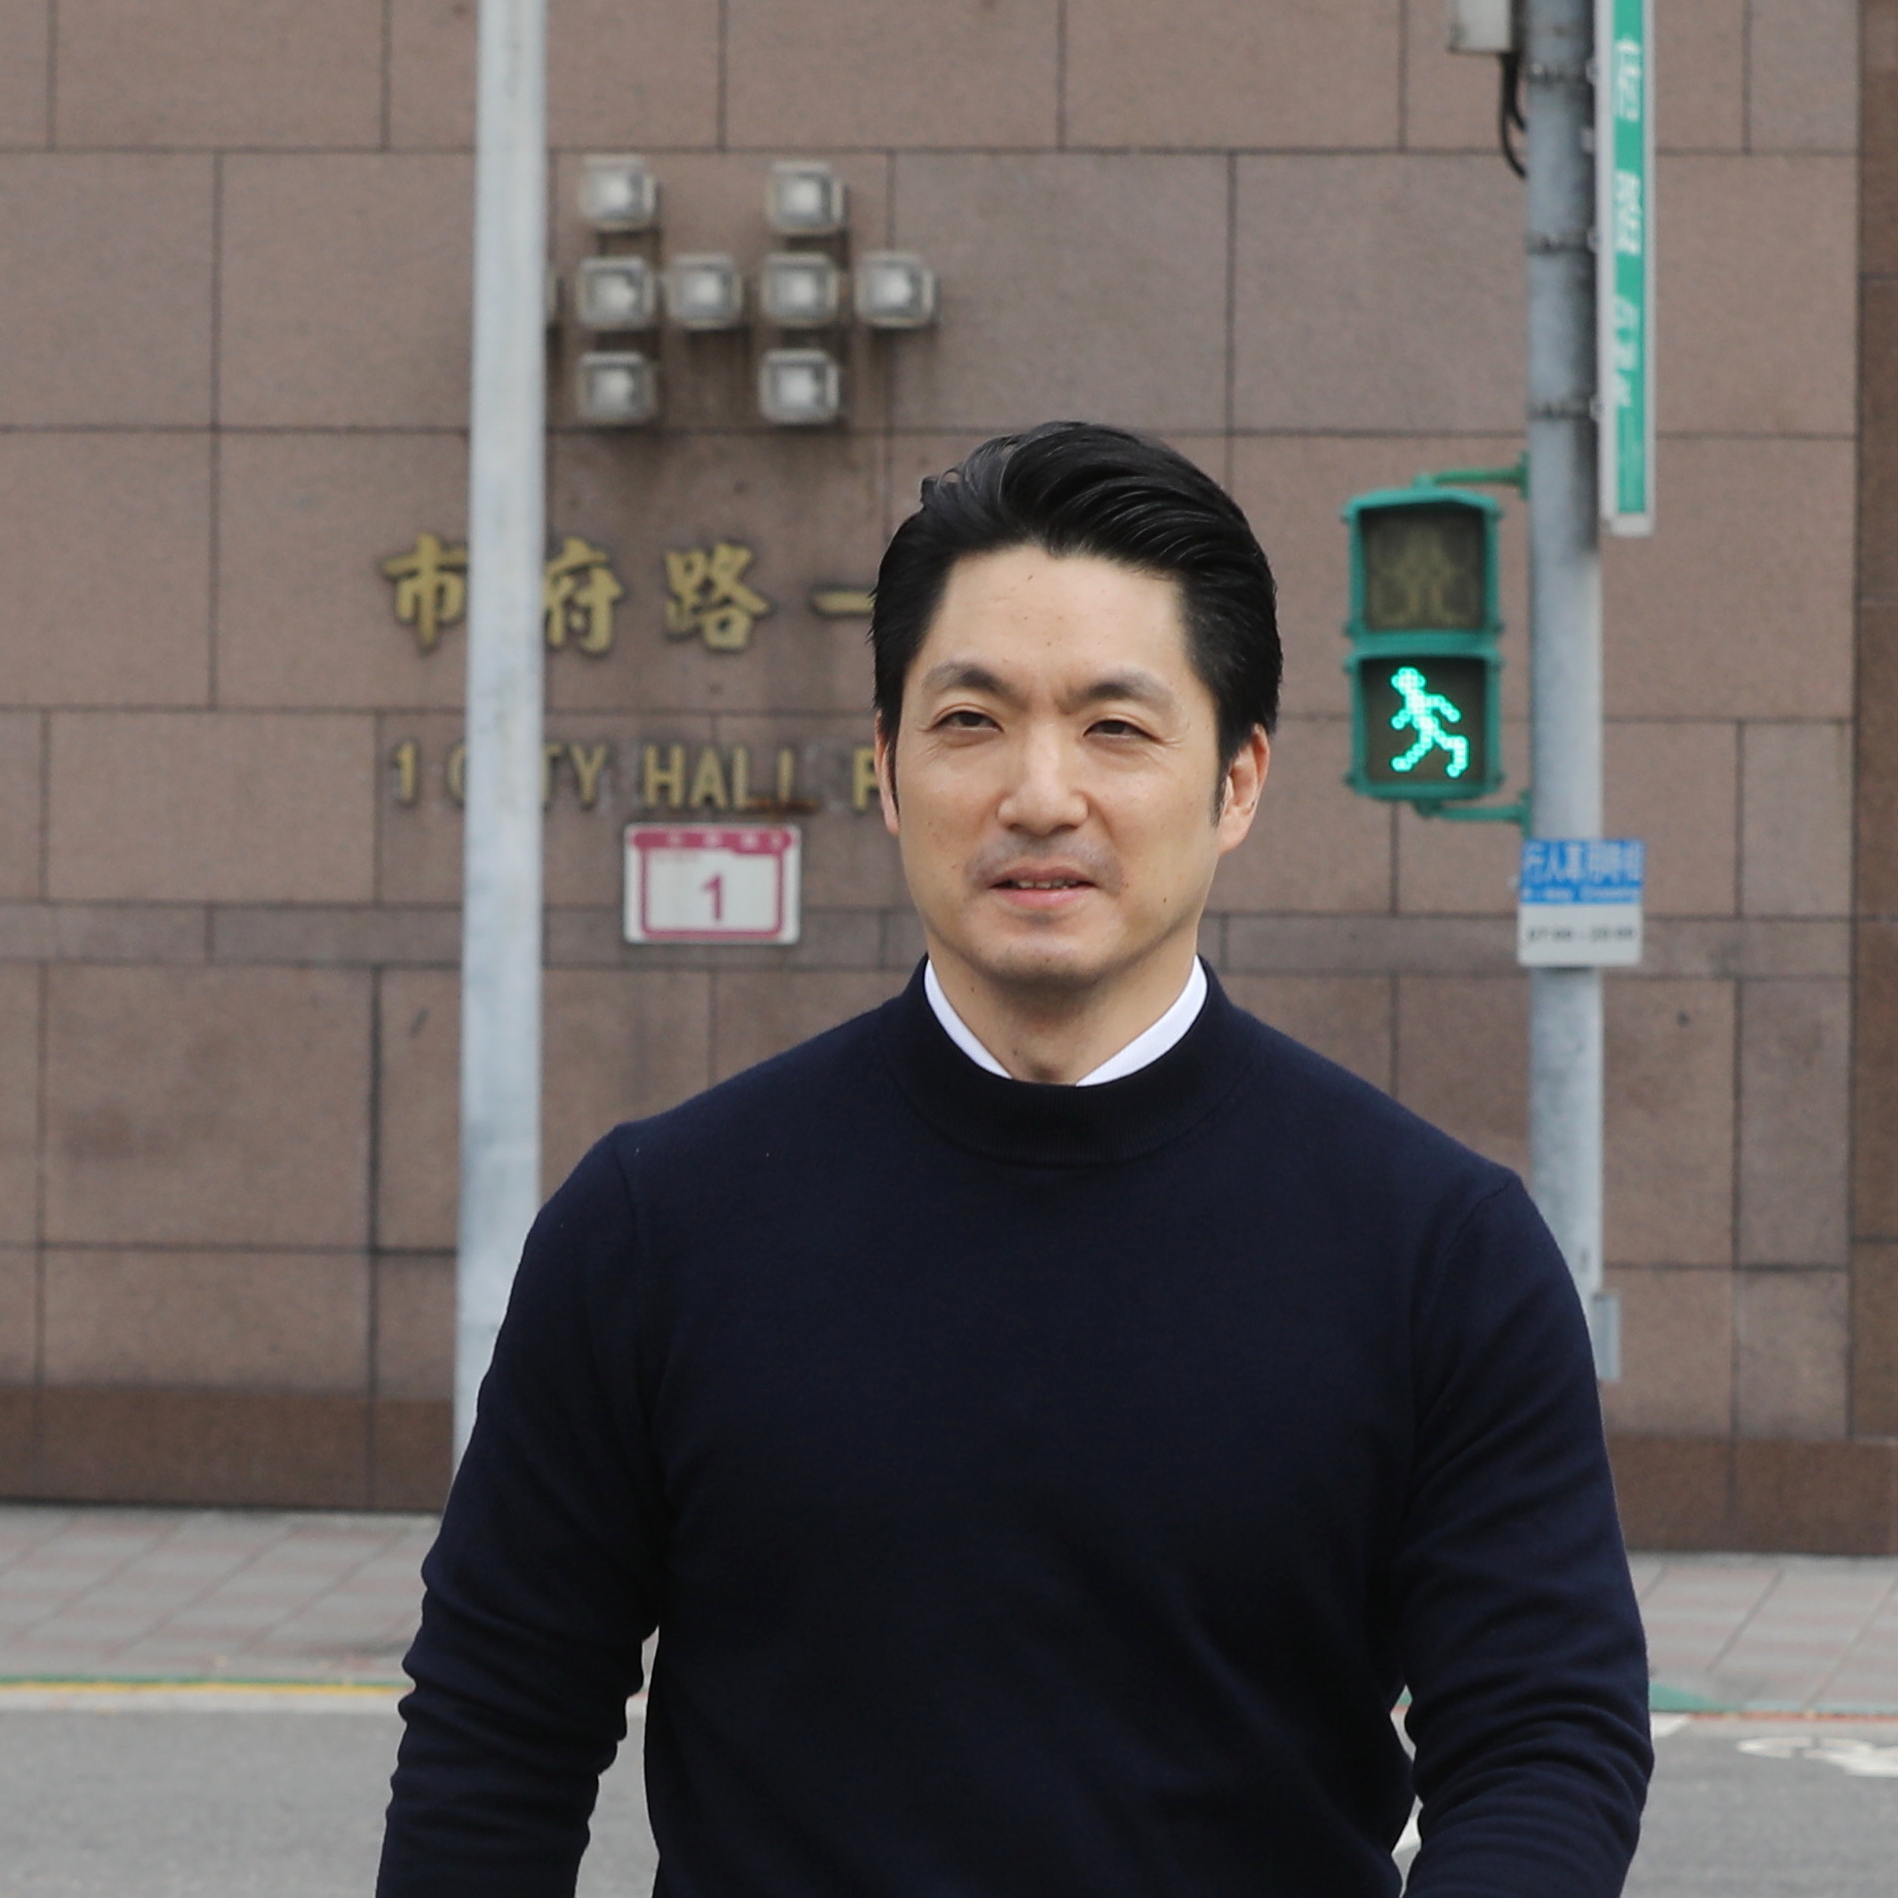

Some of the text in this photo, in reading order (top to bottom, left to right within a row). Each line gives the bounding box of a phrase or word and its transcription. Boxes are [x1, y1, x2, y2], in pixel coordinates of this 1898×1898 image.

[395, 741, 417, 801] 1
[448, 742, 607, 804] CTY
[701, 872, 723, 921] 1
